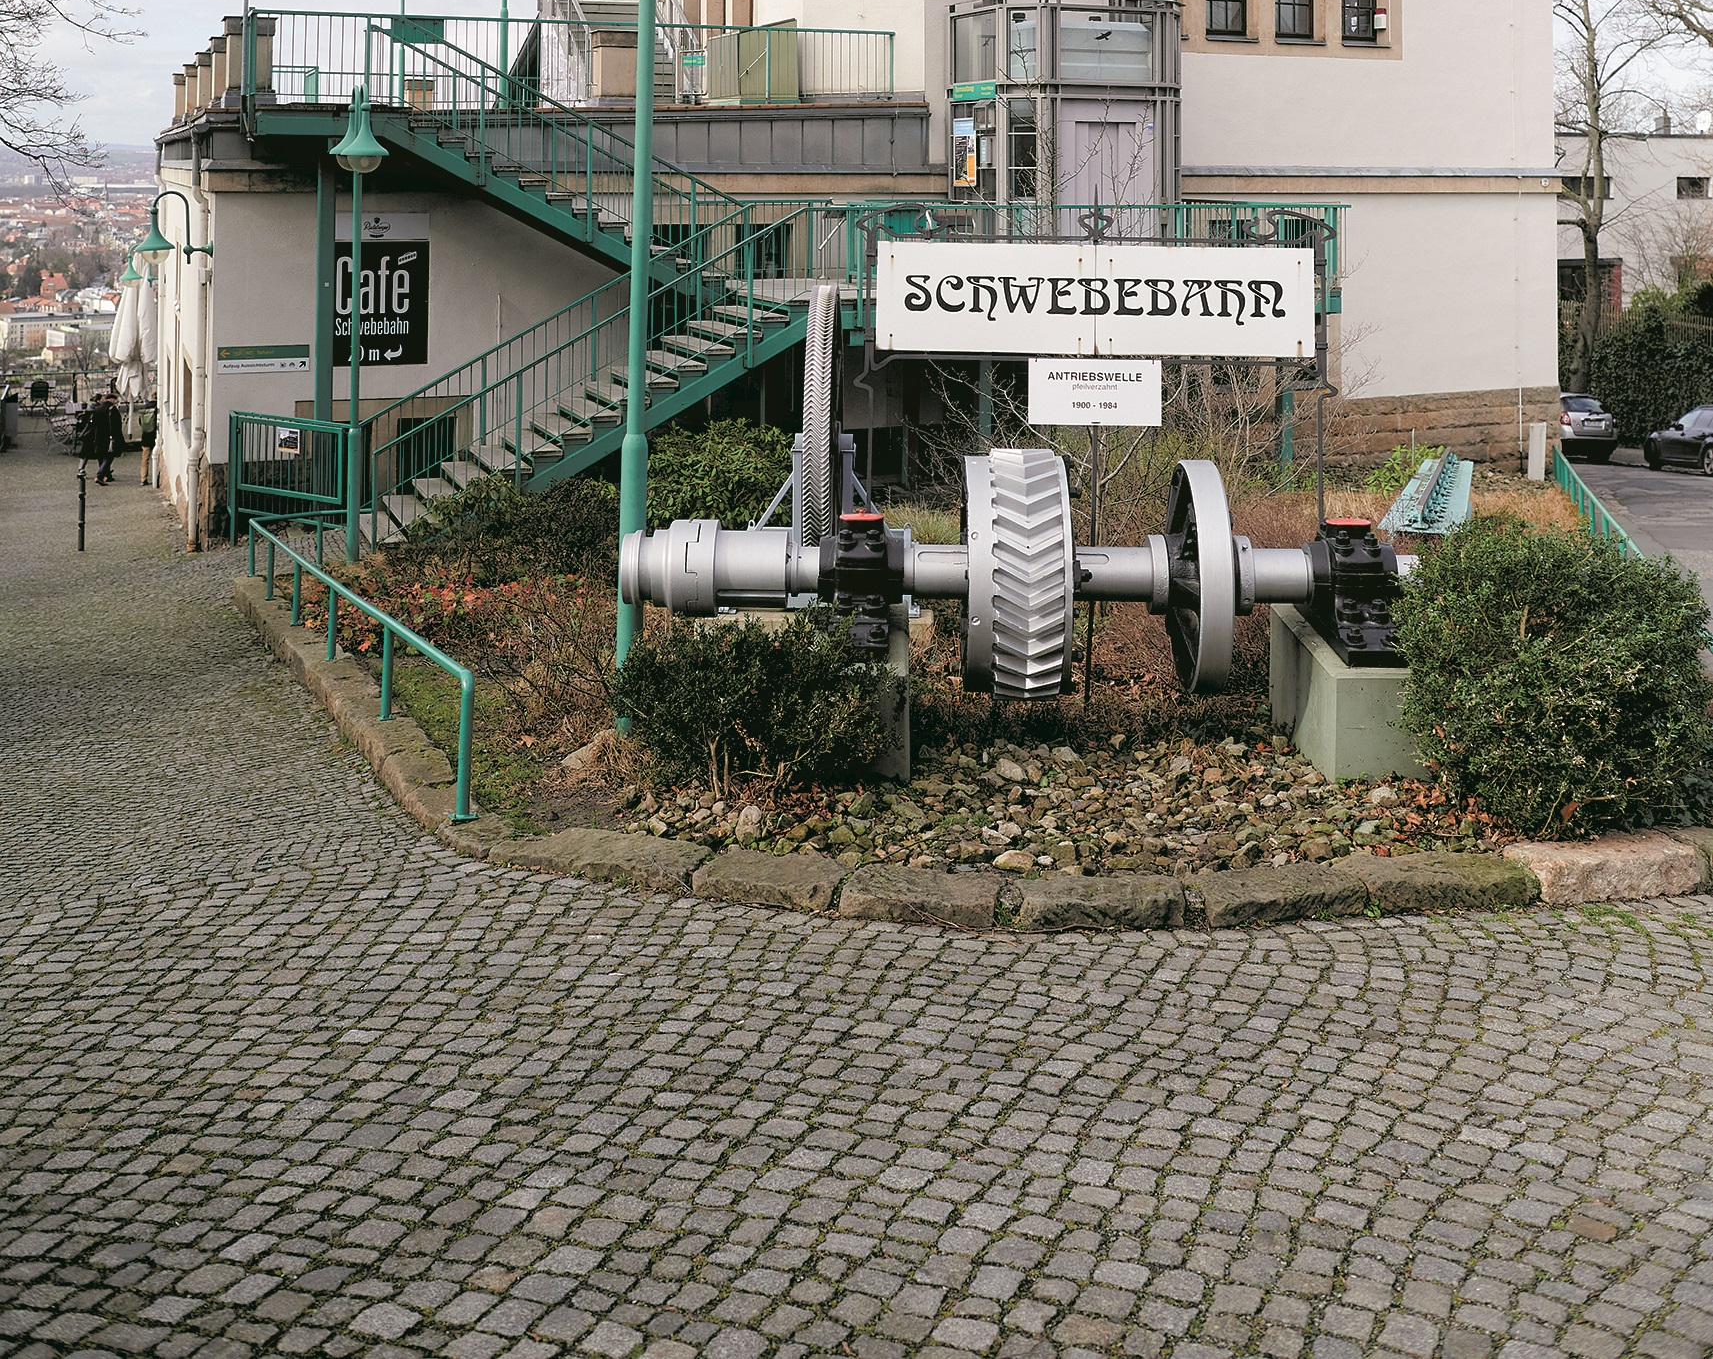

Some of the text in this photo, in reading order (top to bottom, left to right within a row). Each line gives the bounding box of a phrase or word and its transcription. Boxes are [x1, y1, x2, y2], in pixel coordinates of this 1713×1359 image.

[335, 251, 417, 315] Café
[904, 275, 1286, 326] SCHWEBEBAHN
[368, 349, 380, 361] m
[1047, 371, 1143, 382] ANTRIEBSWELLE
[1071, 401, 1091, 409] 1900
[1098, 402, 1118, 410] 1984
